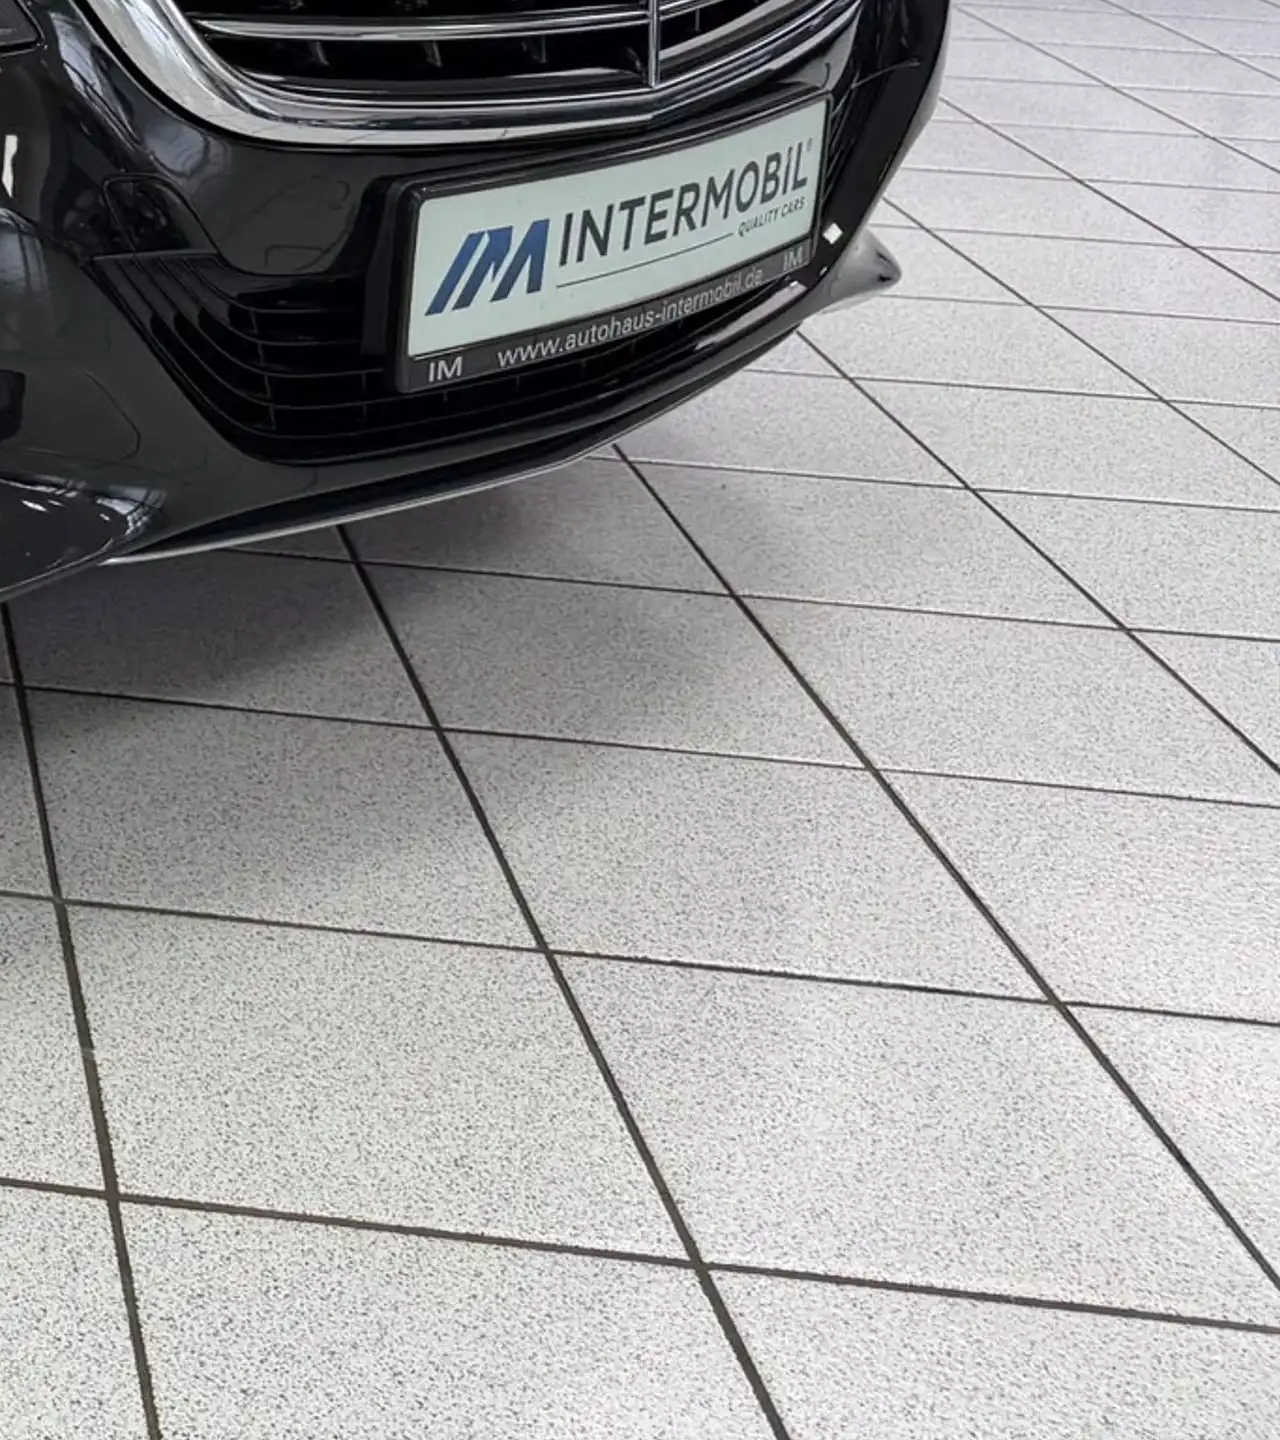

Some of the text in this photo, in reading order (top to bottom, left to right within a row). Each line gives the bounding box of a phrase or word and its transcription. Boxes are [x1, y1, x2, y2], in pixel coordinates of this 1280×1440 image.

[559, 140, 809, 267] INTERMOBIL
[738, 196, 806, 238] QUALITY CARS
[428, 356, 464, 383] IM
[497, 265, 764, 368] www.autohaus-intermobil.de
